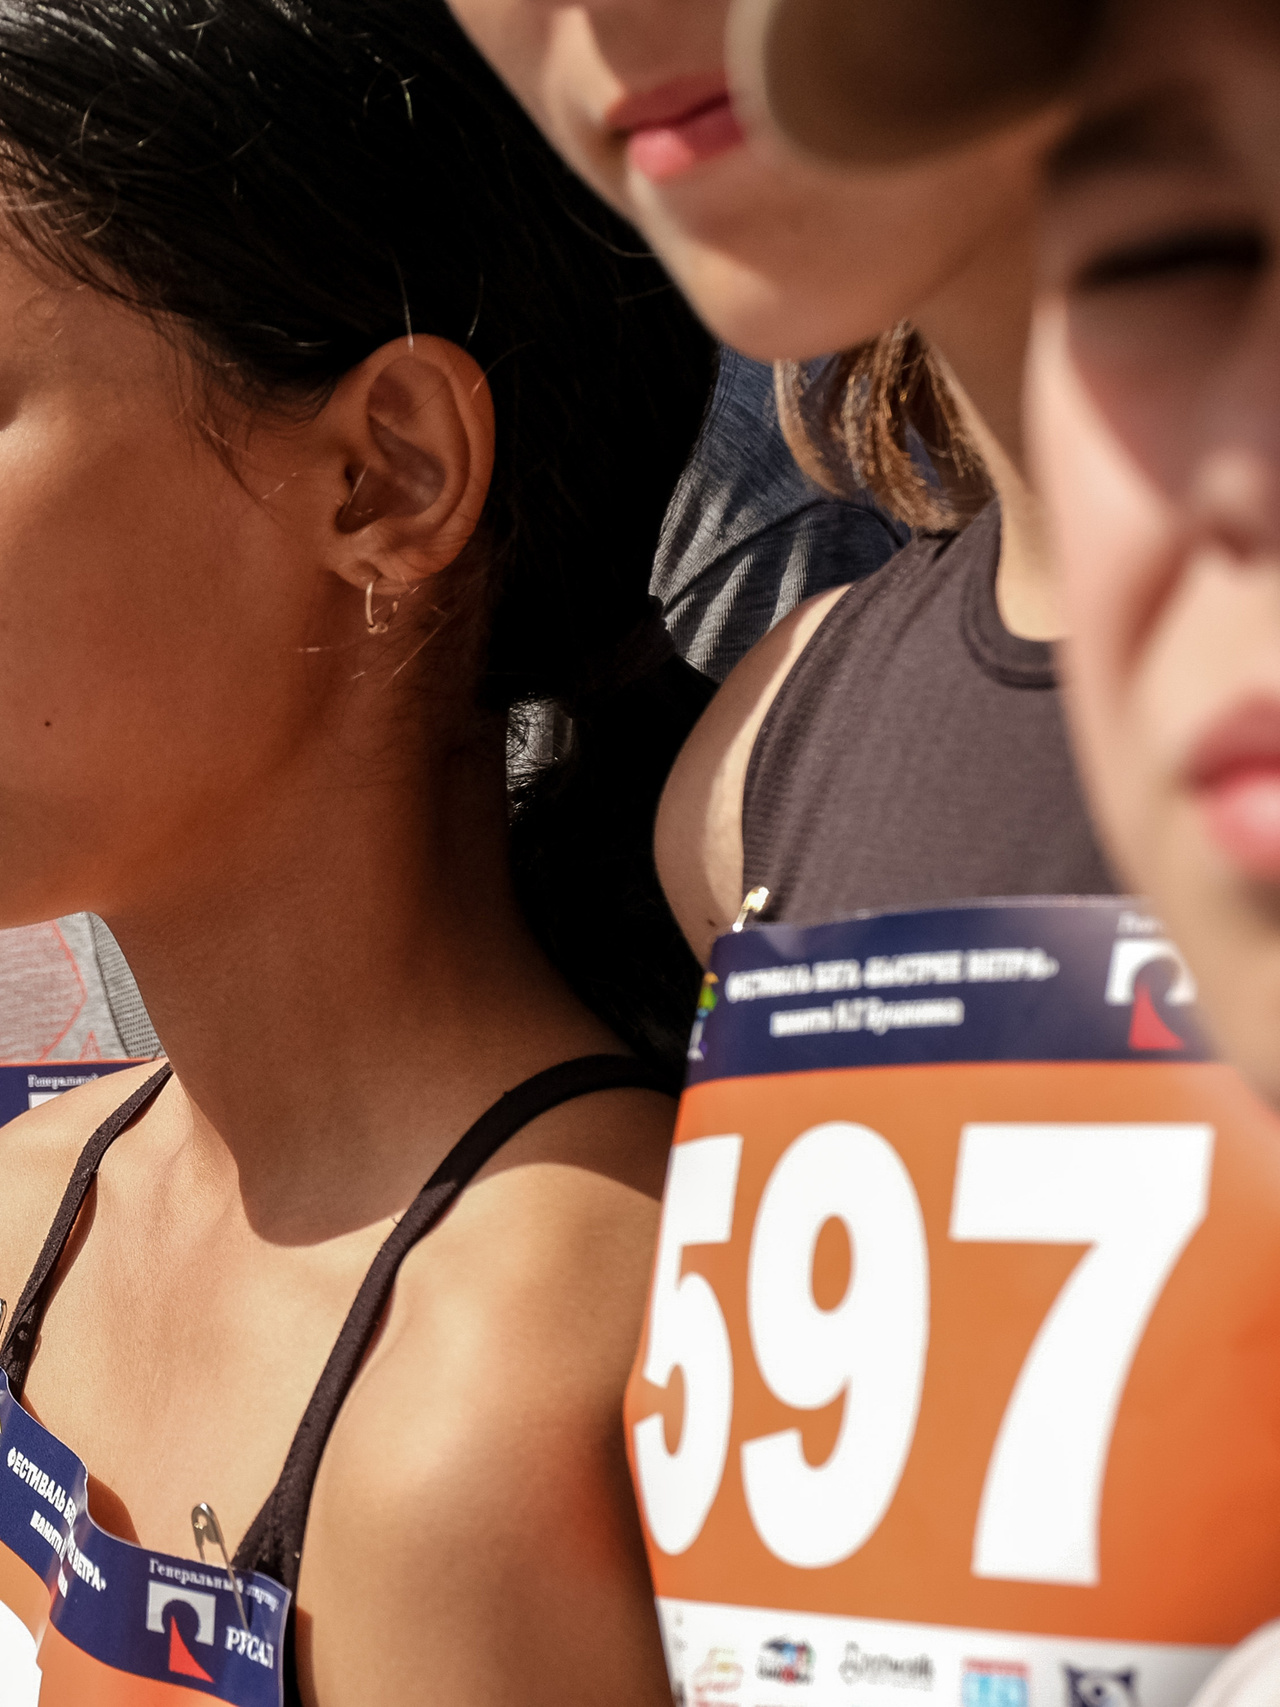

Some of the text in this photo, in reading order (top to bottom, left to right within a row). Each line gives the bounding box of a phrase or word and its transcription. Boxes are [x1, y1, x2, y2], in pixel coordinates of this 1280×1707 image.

[633, 1120, 1215, 1589] 597
[7, 1446, 67, 1514] ФЕСТИВАЛЬ
[149, 1556, 245, 1594] Генеральный
